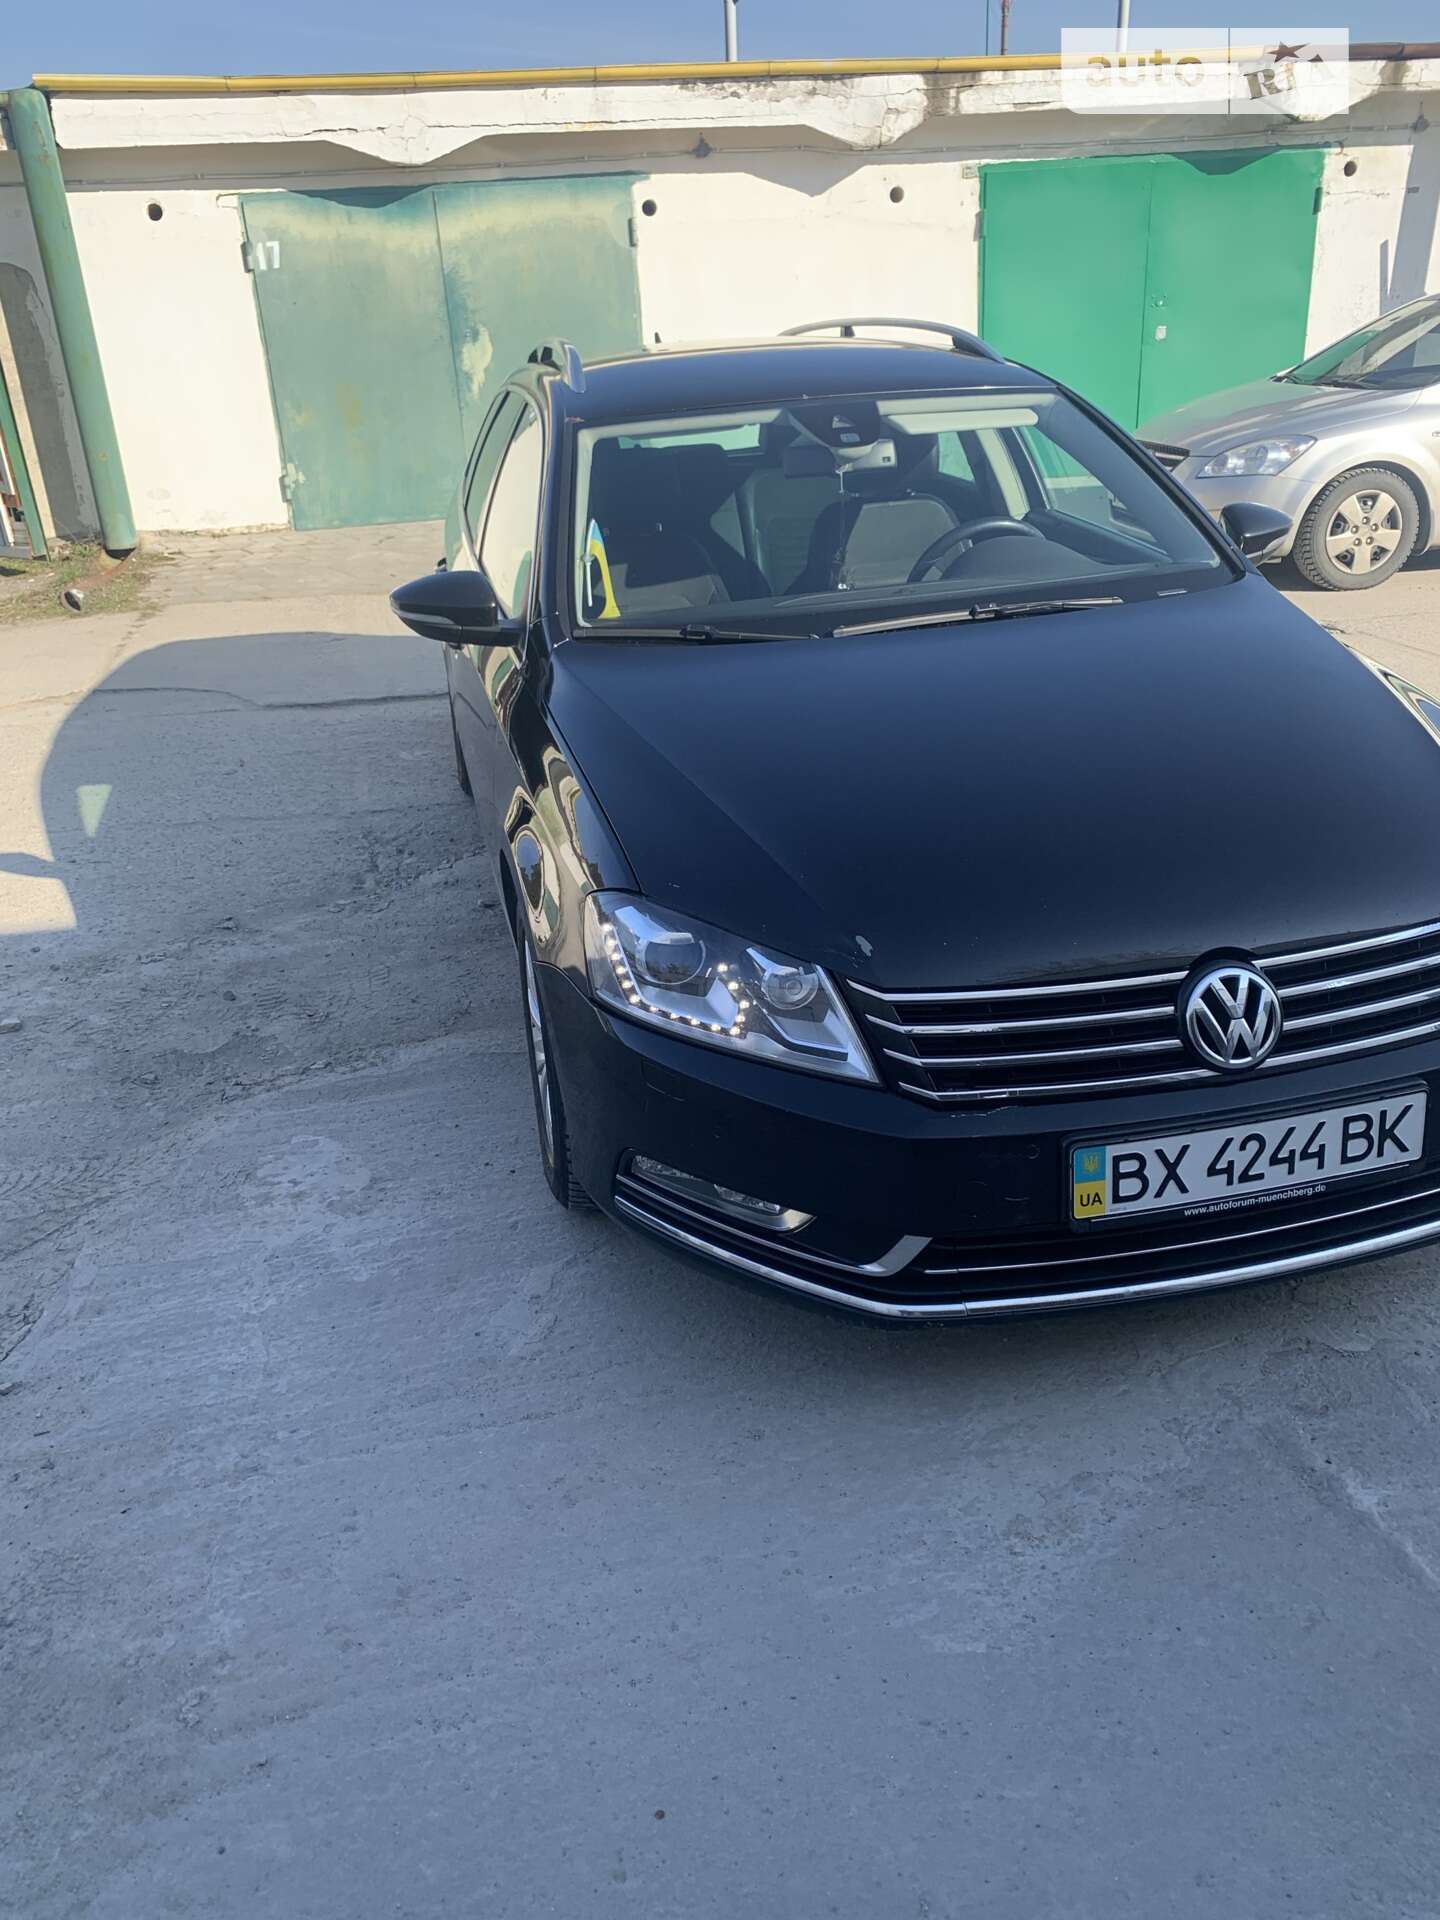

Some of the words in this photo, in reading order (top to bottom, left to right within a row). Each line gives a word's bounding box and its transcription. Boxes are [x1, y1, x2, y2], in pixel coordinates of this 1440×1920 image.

[1111, 1144, 1191, 1204] BX
[1206, 1121, 1327, 1186] 4244
[1340, 1104, 1414, 1165] BK
[1079, 1192, 1103, 1207] UA
[1184, 1184, 1327, 1216] www.autoforum-muenchberg.de
